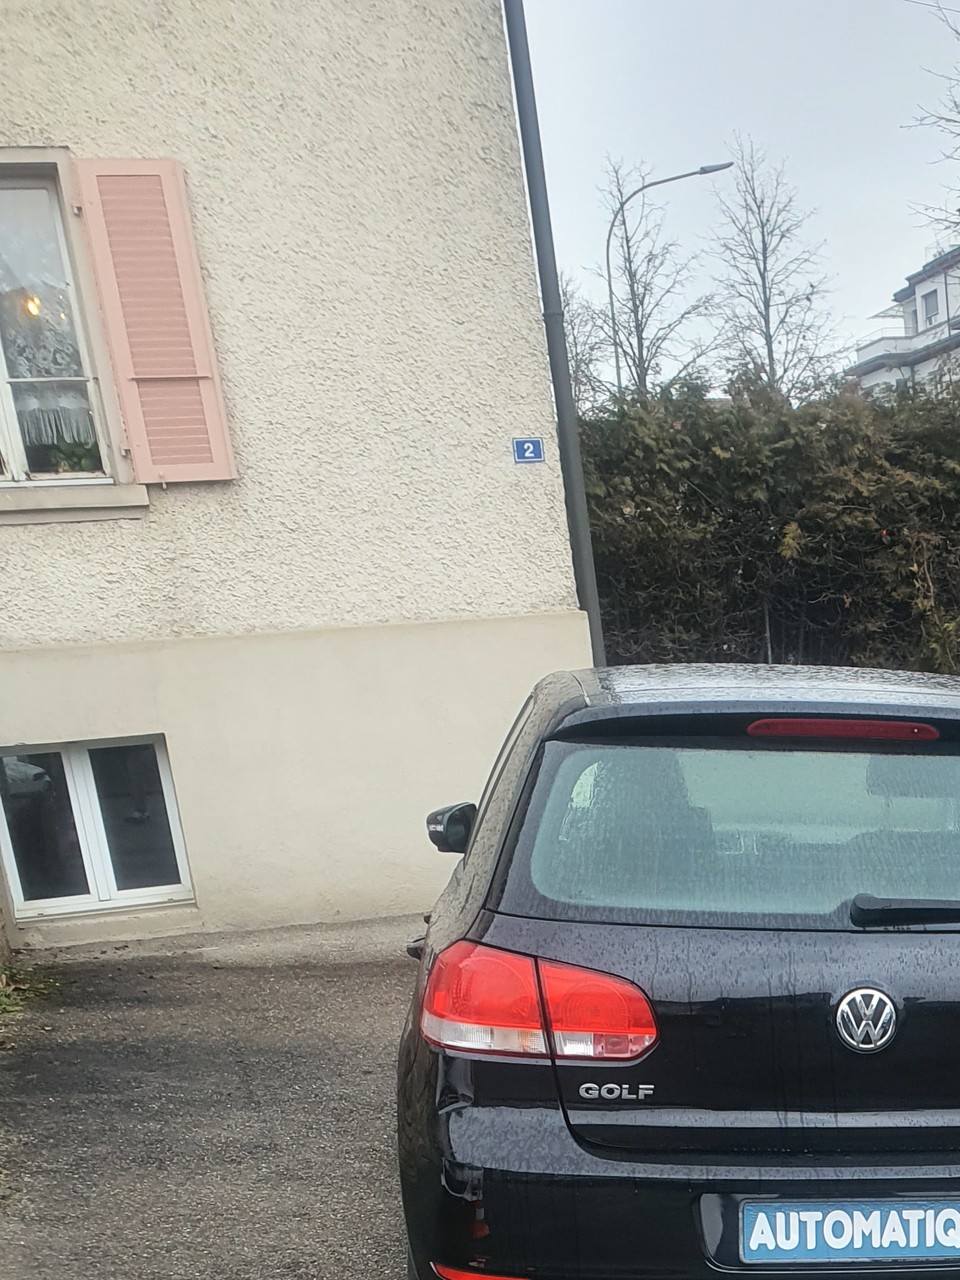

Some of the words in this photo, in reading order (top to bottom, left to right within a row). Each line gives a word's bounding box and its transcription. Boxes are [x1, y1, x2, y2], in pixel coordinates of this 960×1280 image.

[523, 442, 535, 457] 2
[837, 988, 896, 1049] VW
[578, 1082, 655, 1100] GOLF
